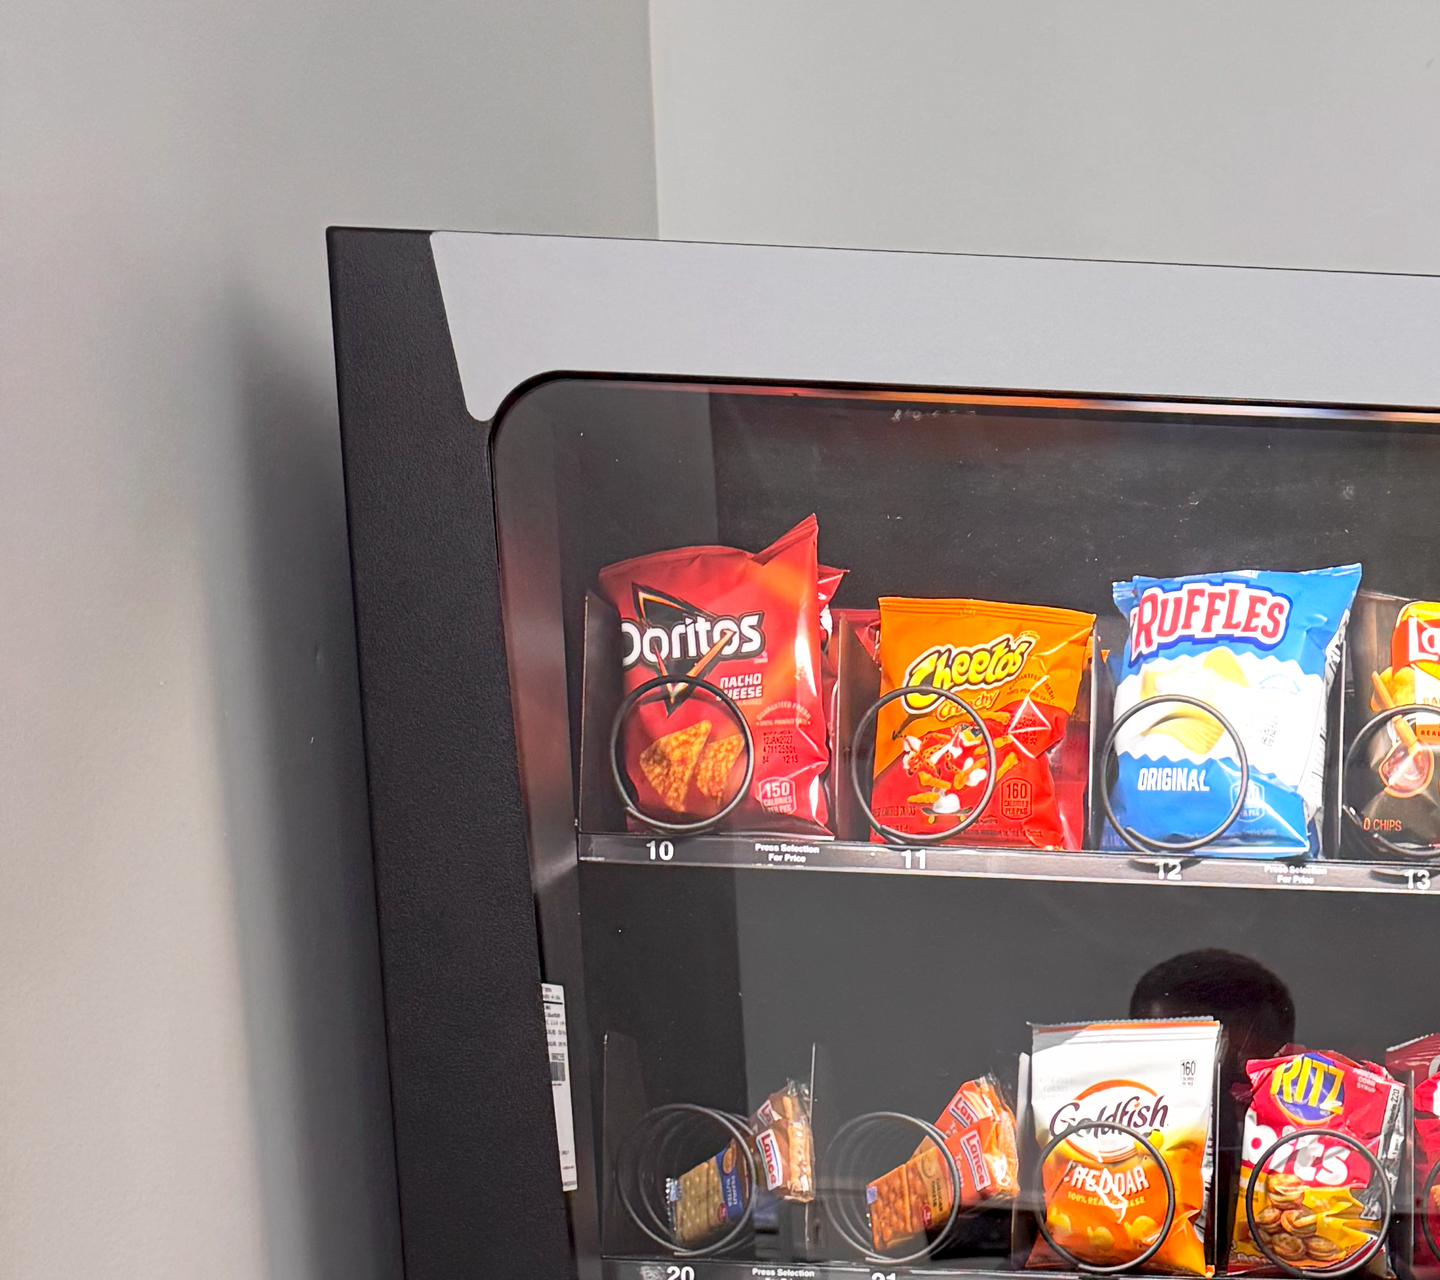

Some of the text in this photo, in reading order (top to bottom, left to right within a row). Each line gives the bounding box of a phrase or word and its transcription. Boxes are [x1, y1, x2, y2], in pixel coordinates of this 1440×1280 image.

[1134, 587, 1285, 651] RUFFLES
[621, 613, 764, 667] Doritos
[904, 637, 1034, 711] Cheetos
[1137, 767, 1211, 792] ORIGINAL
[765, 782, 790, 798] 150
[1006, 783, 1028, 799] 160
[1373, 818, 1402, 832] CHIPS
[646, 840, 675, 861] 10
[755, 842, 820, 855] Press Selection
[768, 853, 807, 864] For Price
[901, 850, 926, 870] 11
[1157, 862, 1183, 881] 12
[1403, 869, 1431, 890] 13
[1181, 1060, 1196, 1077] 160
[1269, 1053, 1346, 1116] RITZ
[1391, 1088, 1401, 1102] 220
[1050, 1094, 1169, 1139] Goldfish
[761, 1133, 778, 1185] Lance
[965, 1133, 986, 1186] Lance
[752, 1268, 816, 1278] Press Selection
